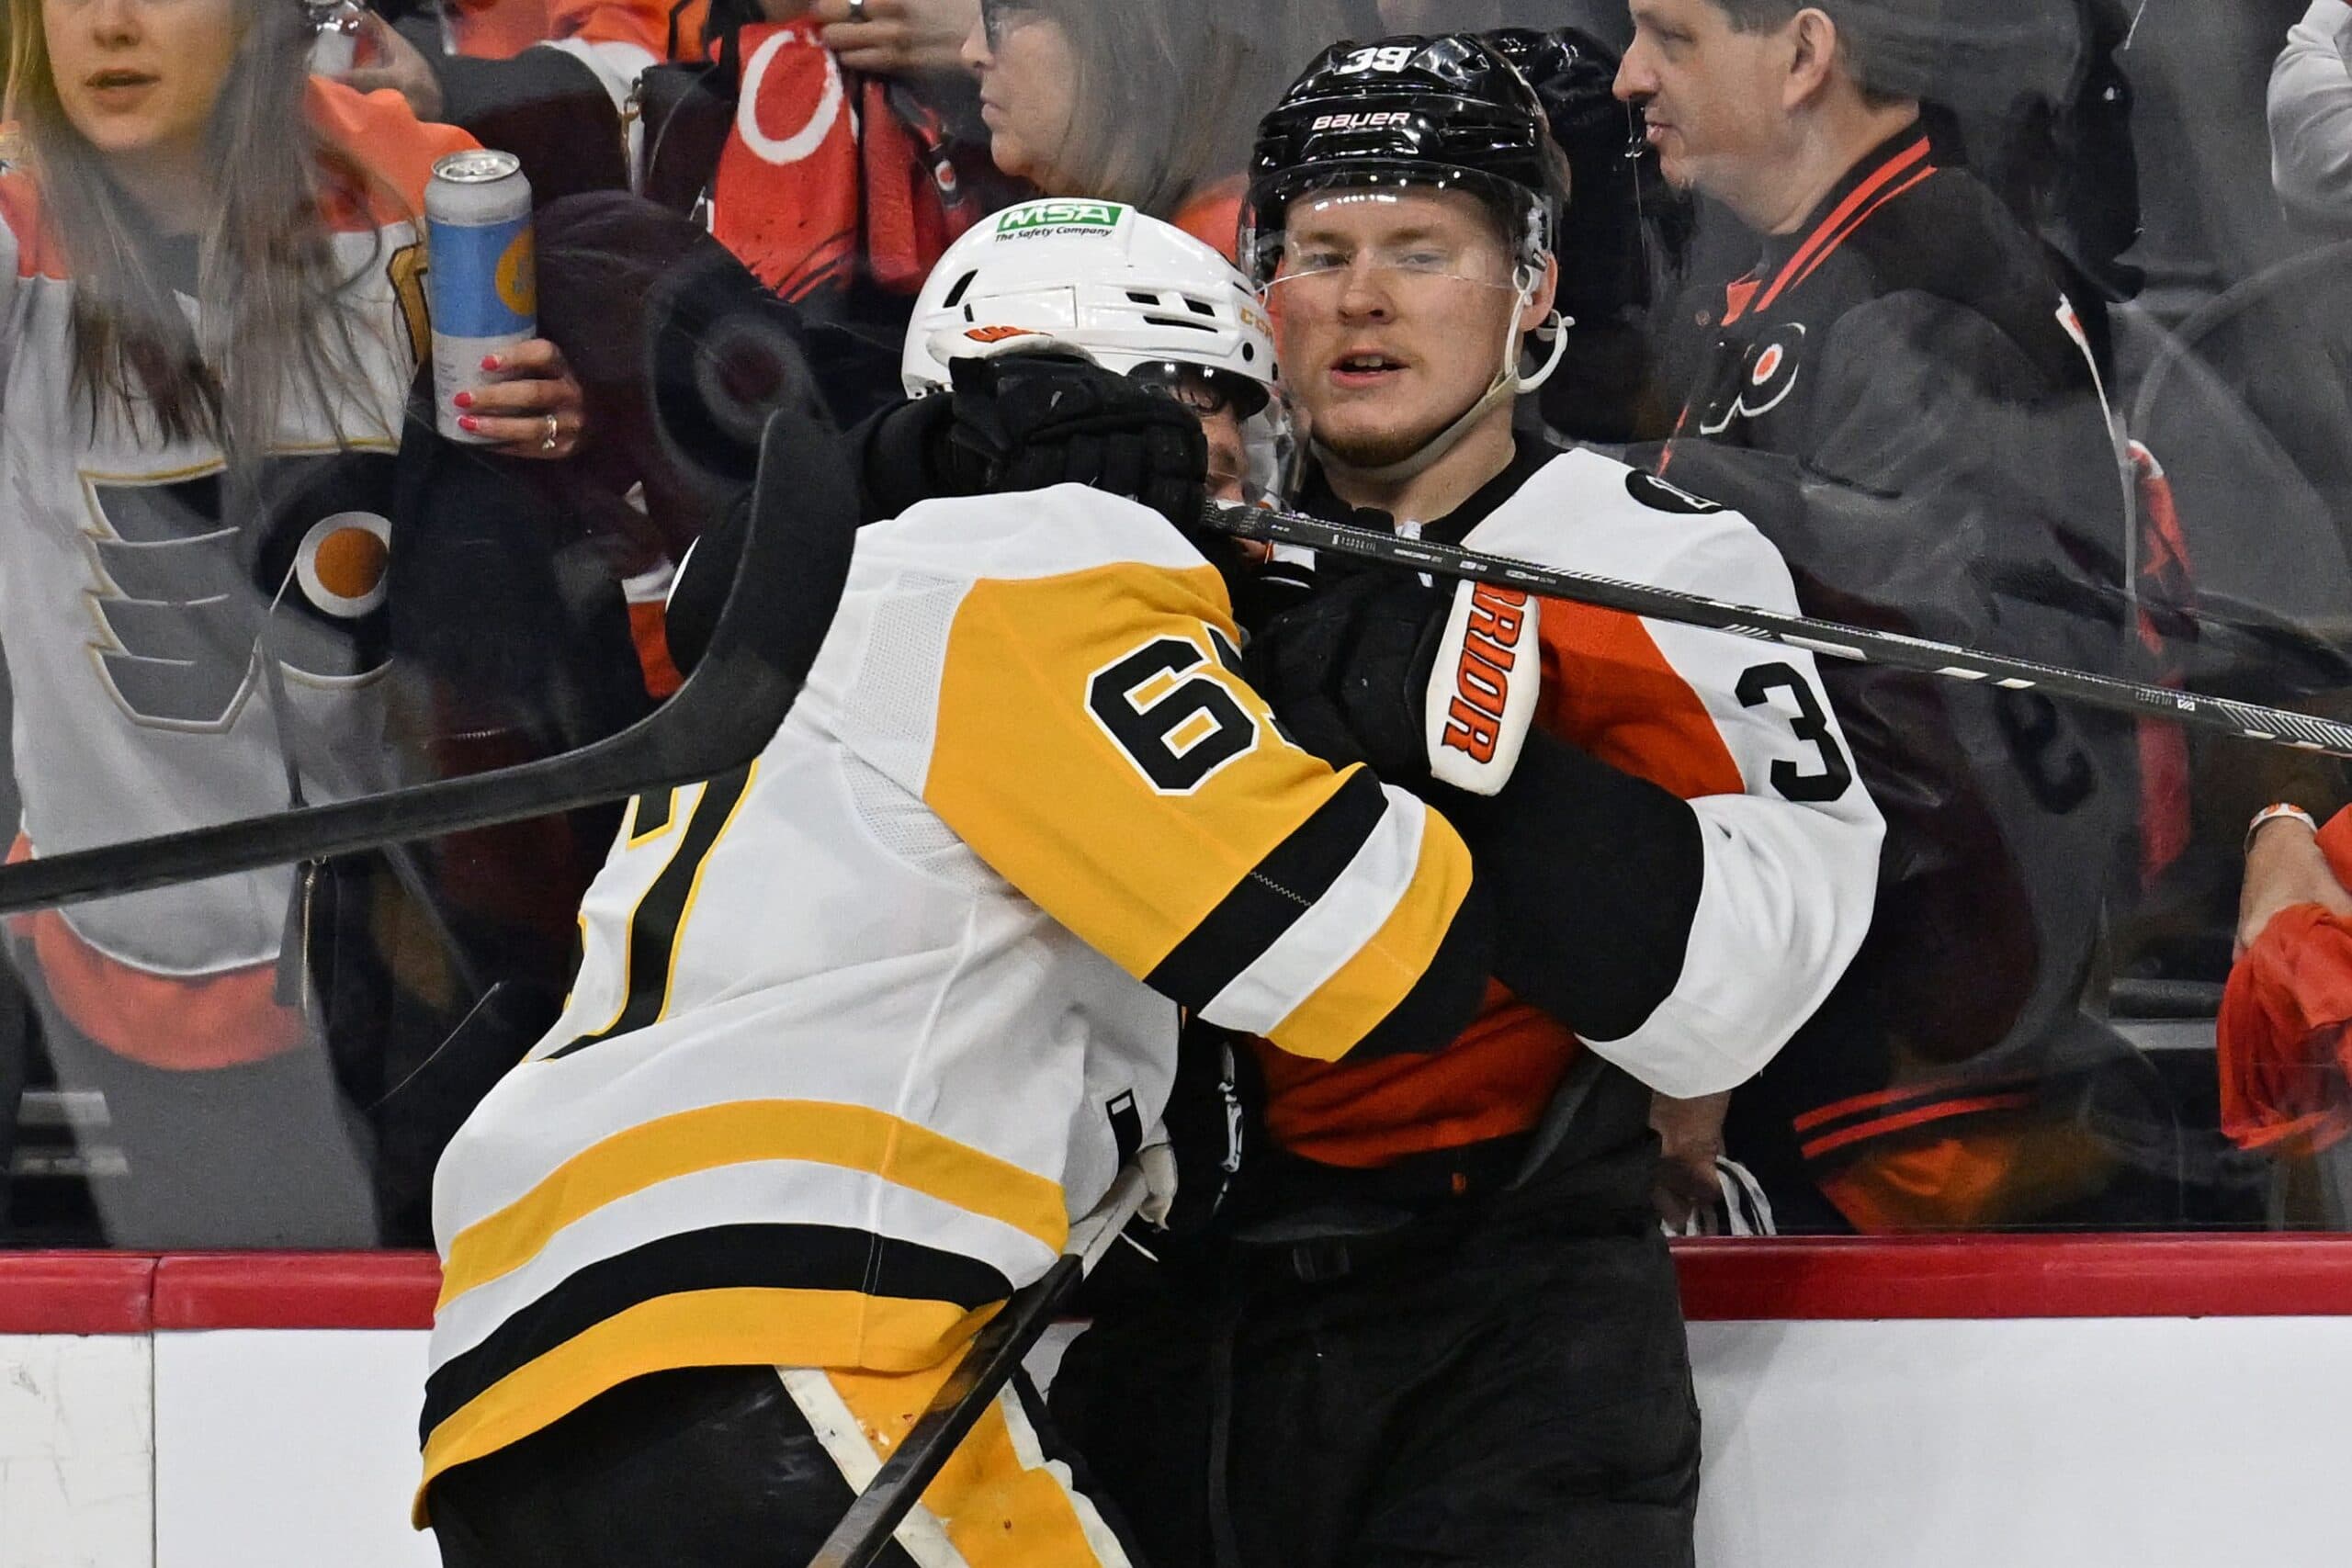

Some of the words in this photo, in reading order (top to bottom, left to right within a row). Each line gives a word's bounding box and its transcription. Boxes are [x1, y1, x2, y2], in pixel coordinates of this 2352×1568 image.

[1333, 47, 1417, 75] 39
[1311, 112, 1411, 131] BAUER
[1001, 203, 1112, 229] MSA
[994, 232, 1014, 243] The
[1017, 226, 1054, 240] Safety
[1056, 226, 1114, 237] Company
[1735, 661, 1853, 802] 3
